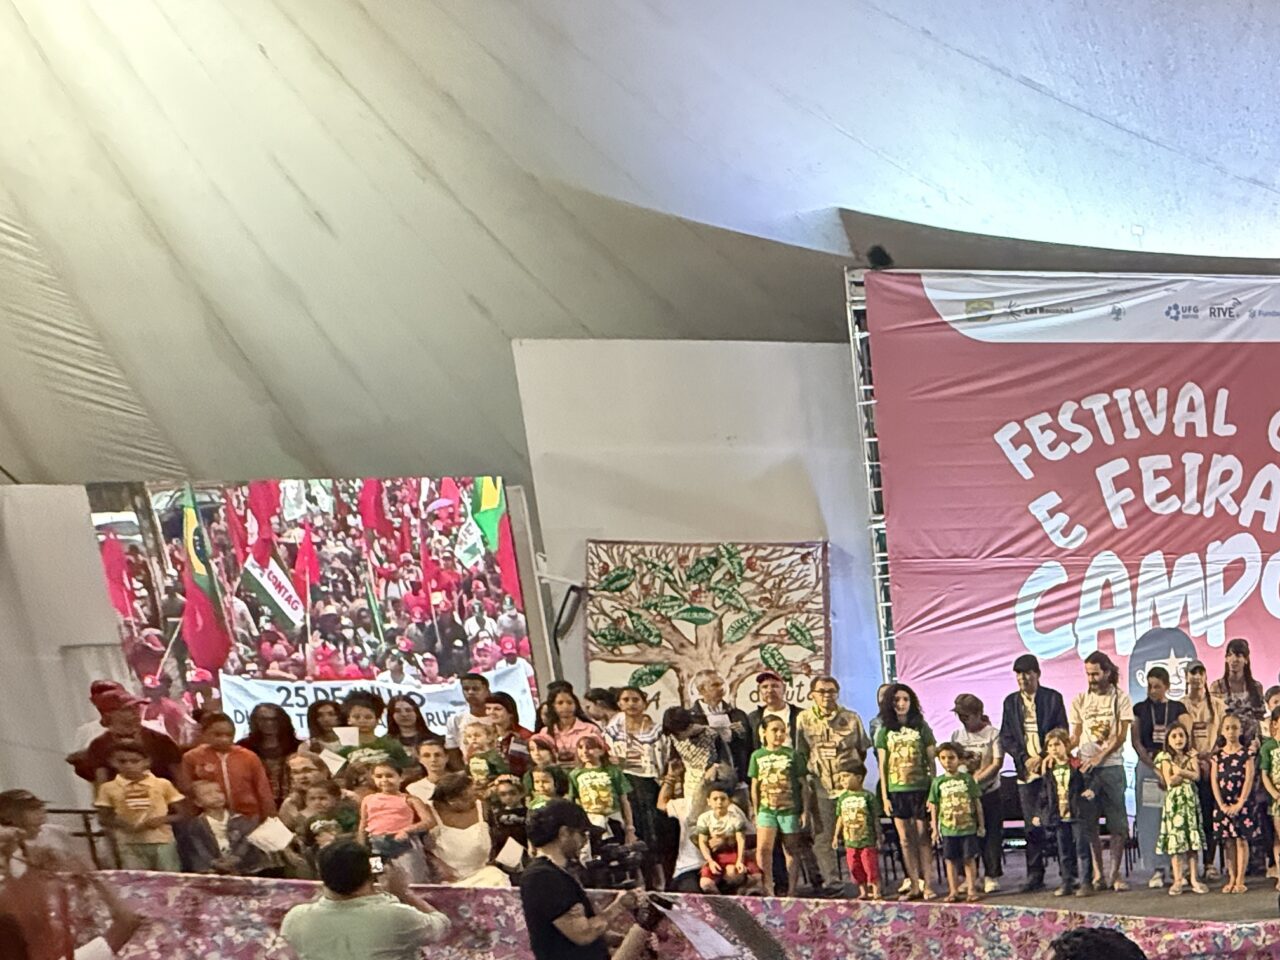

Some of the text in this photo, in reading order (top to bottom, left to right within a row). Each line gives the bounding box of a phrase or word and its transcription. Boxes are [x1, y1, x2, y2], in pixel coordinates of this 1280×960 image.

[1181, 305, 1200, 314] UFG
[994, 382, 1238, 480] FESTIVAL
[1029, 490, 1089, 549] E
[267, 569, 301, 612] CONTAG
[276, 686, 308, 708] 25
